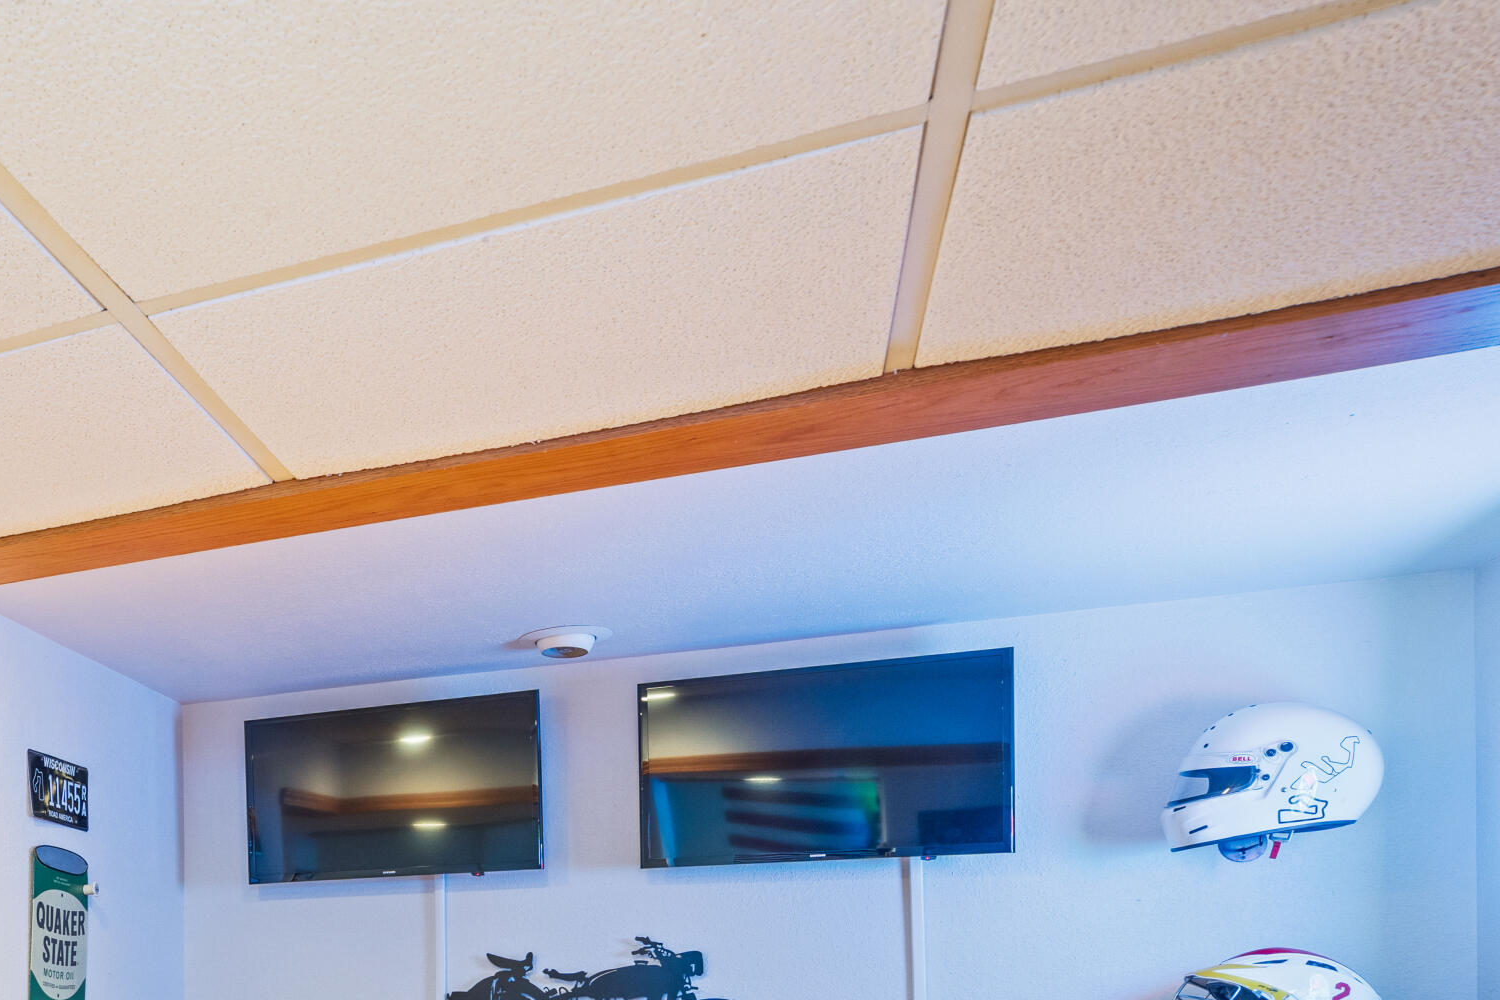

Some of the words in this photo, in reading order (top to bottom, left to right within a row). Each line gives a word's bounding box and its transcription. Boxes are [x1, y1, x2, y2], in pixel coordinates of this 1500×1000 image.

[43, 756, 76, 777] WISCONSIN
[48, 774, 81, 815] 11455
[36, 901, 86, 937] QUAKER
[42, 935, 78, 967] STATE
[43, 967, 64, 980] MOTOR
